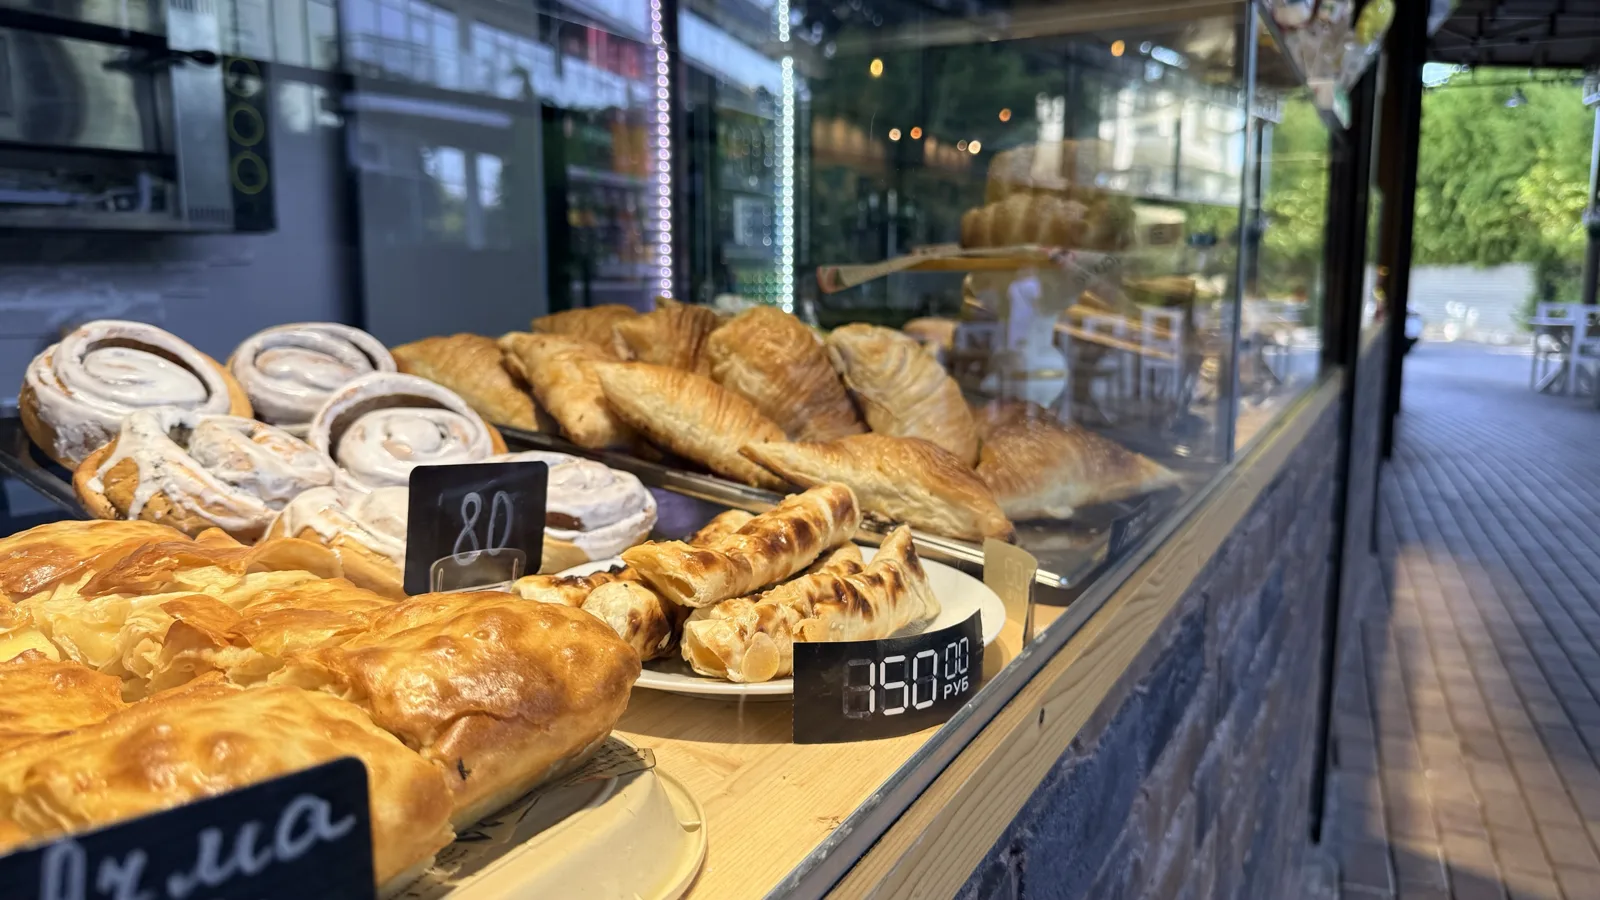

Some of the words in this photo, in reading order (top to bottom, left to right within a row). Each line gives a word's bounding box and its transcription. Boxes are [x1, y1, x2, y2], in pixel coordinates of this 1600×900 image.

[453, 490, 514, 566] 80
[869, 649, 938, 716] 150
[944, 636, 969, 680] 00
[943, 676, 969, 700] РУБ
